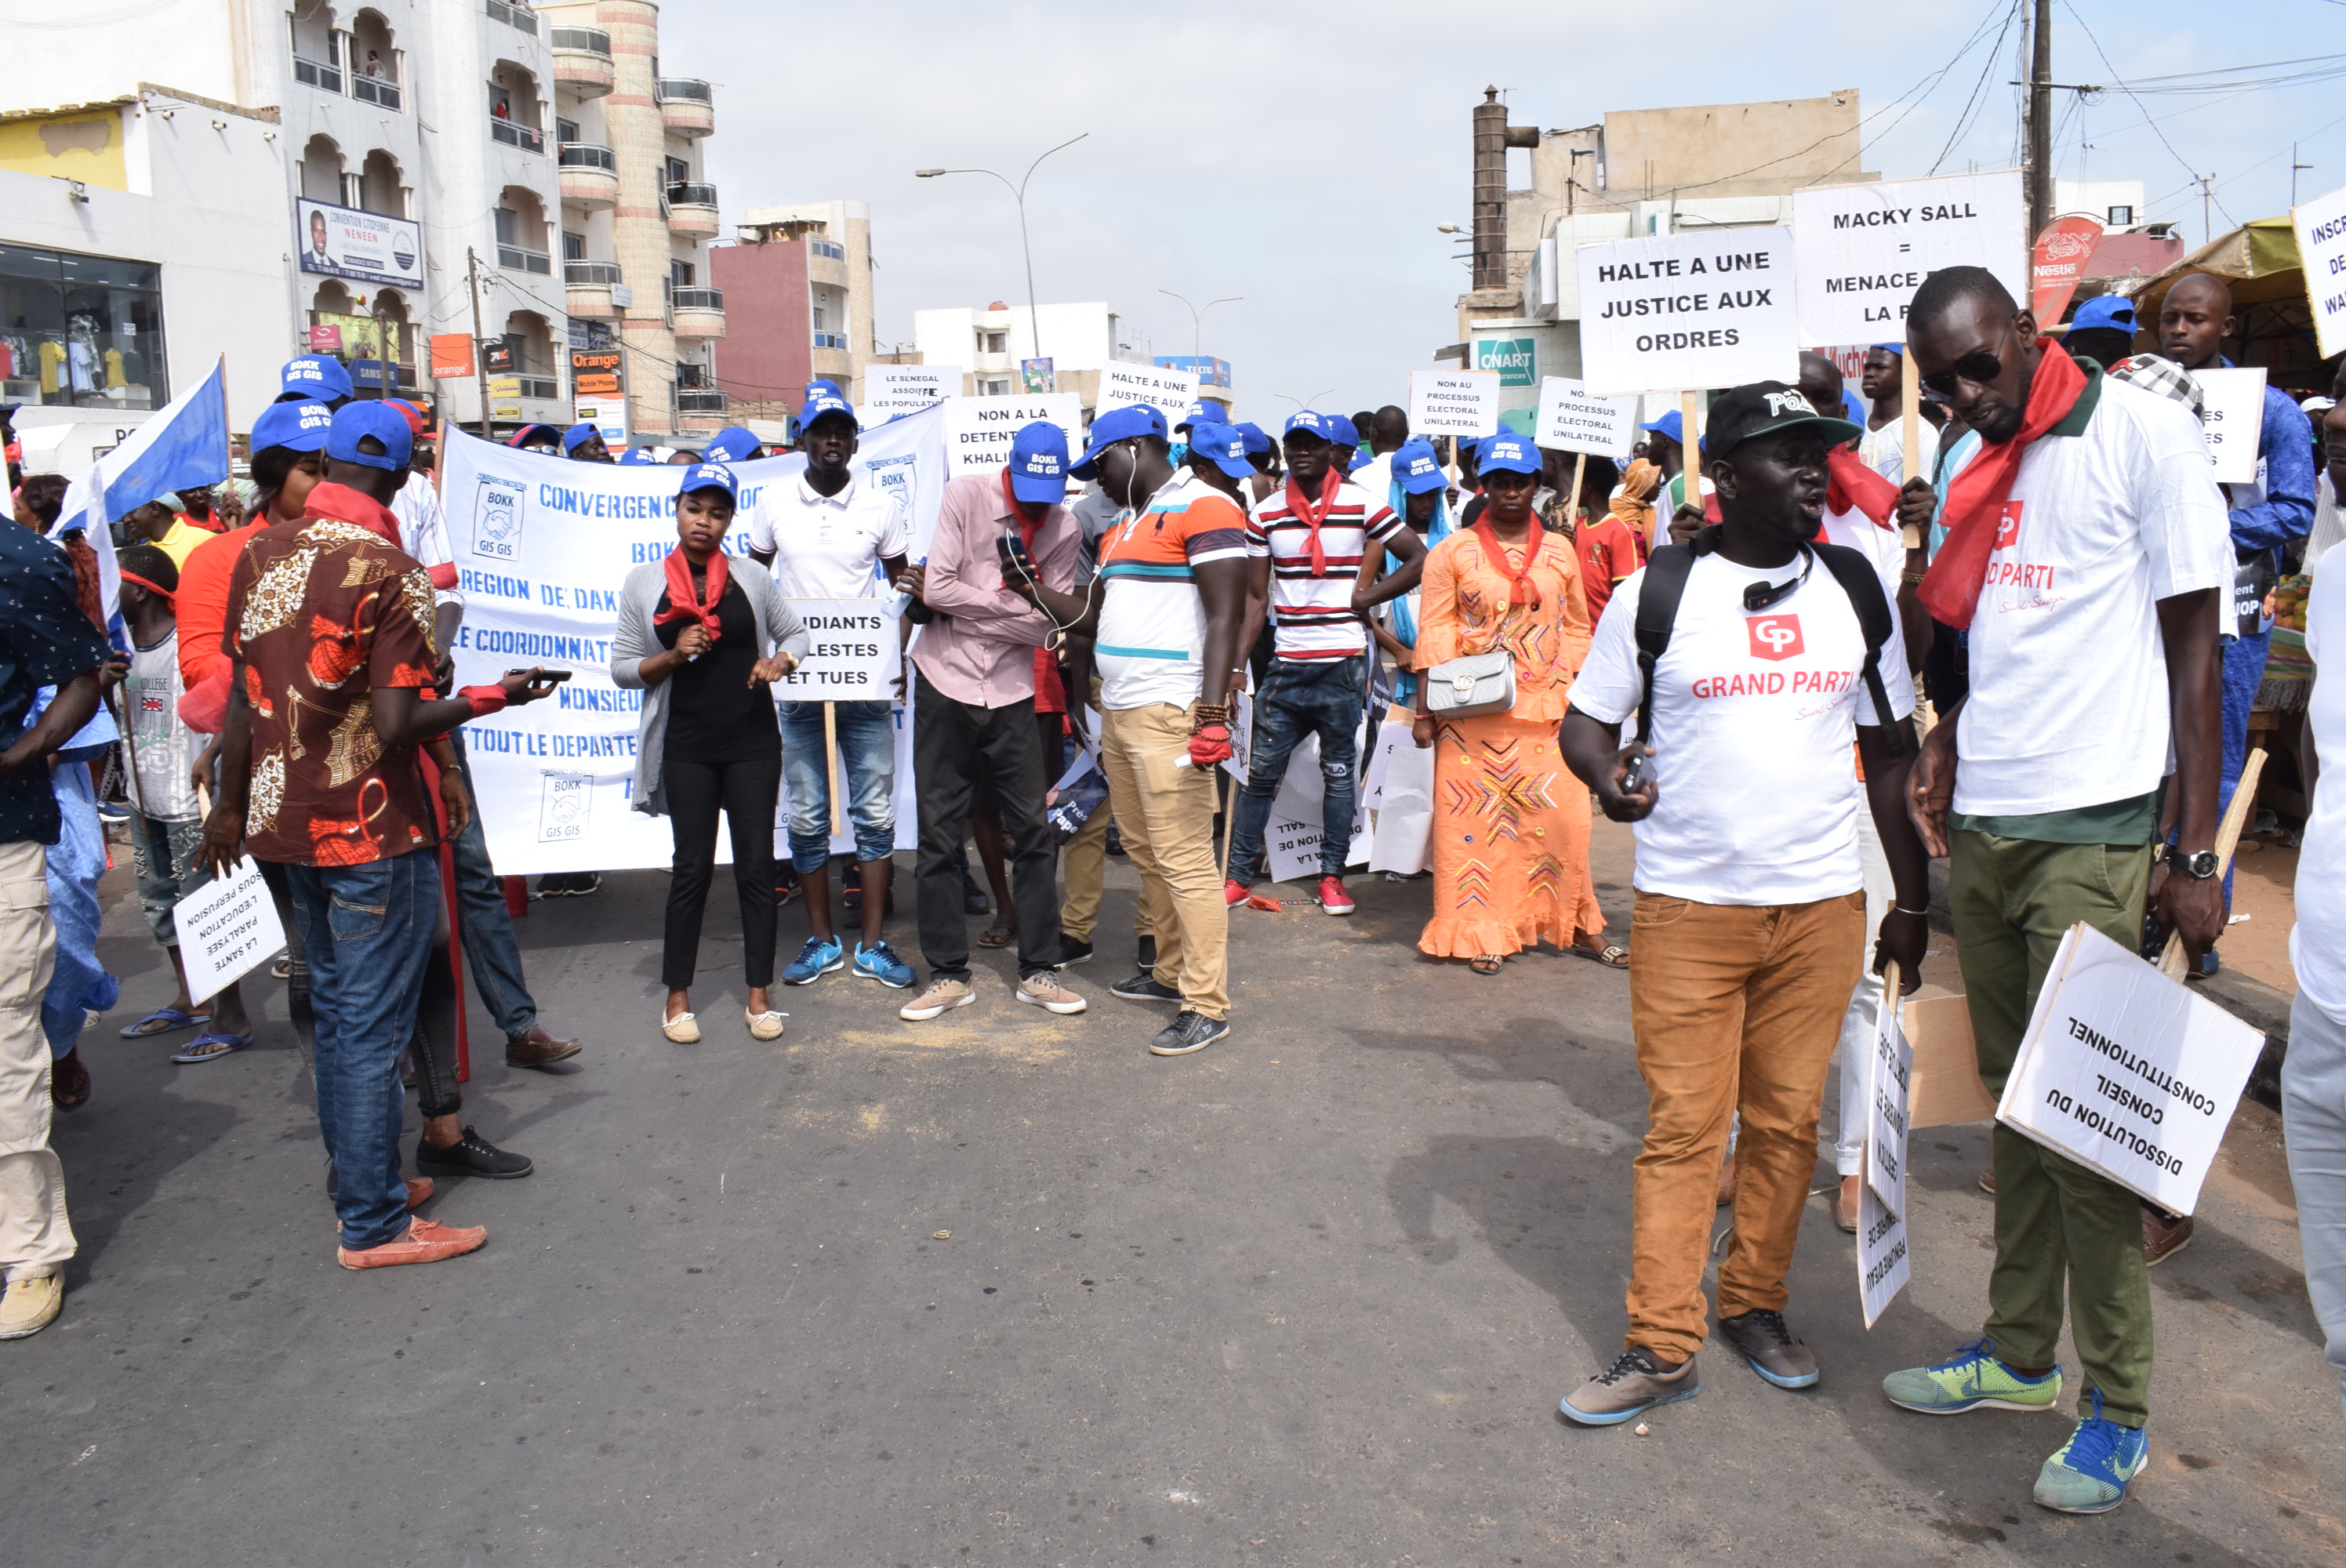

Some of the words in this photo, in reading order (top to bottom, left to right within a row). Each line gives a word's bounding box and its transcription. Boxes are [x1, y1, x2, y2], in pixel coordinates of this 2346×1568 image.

[330, 212, 361, 227] CONVENTION
[363, 218, 390, 234] CITOYENNE
[1833, 208, 1912, 229] MACKY
[1920, 203, 1977, 222] SALL
[345, 228, 378, 242] NENEEN
[1599, 260, 1680, 282] HALTE
[1690, 257, 1707, 274] A
[1716, 252, 1770, 273] UNE
[1826, 272, 1919, 293] MENACE
[1600, 294, 1709, 319] JUSTICE
[1717, 289, 1773, 310] AUX
[2325, 291, 2346, 315] WA
[1864, 307, 1891, 322] LA
[1636, 328, 1740, 352] ORDRES
[289, 361, 320, 371] BOKK
[572, 354, 619, 369] Orange
[286, 370, 302, 383] GIS
[303, 370, 323, 381] GIS
[360, 368, 395, 380] SAMSG
[434, 365, 467, 376] orange
[1186, 365, 1213, 374] TECNO
[1111, 372, 1149, 387] HALTE
[1152, 379, 1160, 388] A
[1164, 381, 1188, 393] UNE
[1437, 380, 1458, 389] NON
[818, 397, 844, 406] BOKK
[1109, 390, 1157, 405] JUSTICE
[1161, 398, 1186, 409] AUX
[1427, 393, 1480, 402] PROCESSUS
[1571, 390, 1585, 398] NO
[979, 410, 1009, 421] NON
[1015, 410, 1025, 419] A
[1030, 408, 1048, 419] LA
[1295, 412, 1317, 421] BOKK
[1427, 405, 1479, 415] ELECTORAL
[1559, 402, 1617, 416] PROCESSUS
[300, 416, 322, 430] GIS
[1424, 418, 1480, 428] UNILATERAL
[1557, 416, 1614, 430] ELECTORAL
[961, 430, 1016, 443] DETENT
[1553, 430, 1614, 445] UNILATERAL
[1495, 442, 1520, 452] BOKK
[717, 452, 732, 462] GIS
[964, 452, 1010, 464] KHALI
[1032, 453, 1057, 464] BOKK
[1411, 457, 1431, 467] BOKK
[1491, 451, 1505, 459] GIS
[1506, 451, 1523, 460] GIS
[703, 464, 730, 478] BOKK
[1026, 463, 1044, 473] GIS
[1045, 465, 1060, 474] GIS
[1411, 467, 1424, 476] GIS
[1424, 463, 1436, 473] GIS
[697, 470, 715, 479] GIS
[716, 474, 731, 488] GIS
[881, 472, 906, 487] BOKK
[487, 492, 514, 507] BOKK
[539, 483, 675, 519] CONVERGENC
[479, 539, 495, 553] GIS
[496, 543, 513, 556] GIS
[631, 541, 674, 564] BOK
[1999, 562, 2054, 590] PARTI
[461, 568, 530, 601] REGION
[540, 583, 567, 608] DE
[574, 586, 620, 612] DAK
[803, 616, 881, 630] DIANTS
[1756, 620, 1796, 652] GP
[476, 629, 614, 663] COORDONNAT
[140, 677, 168, 691] COLLEGE
[787, 671, 811, 684] ET
[817, 671, 868, 684] TUES
[1692, 672, 1785, 699] GRAND
[1792, 671, 1854, 694] PARTI
[558, 686, 644, 713] MONSIEU
[470, 726, 524, 755] TOUT
[528, 733, 547, 757] LE
[553, 735, 638, 757] DEPARTE
[554, 780, 582, 792] BOKK
[1051, 810, 1079, 834] Pape
[547, 827, 561, 838] GIS
[565, 826, 580, 837] GIS
[1279, 841, 1295, 851] DE
[1296, 853, 1312, 865] LA
[238, 870, 262, 893] SOUS
[187, 888, 237, 928] PERFUSION
[199, 895, 258, 941] L'EDUCATION
[206, 916, 258, 956] PARALYSEE
[245, 936, 258, 950] LA
[214, 946, 245, 972] SANTE
[2068, 1016, 2216, 1116] CONSTITUTIONNEL
[2046, 1088, 2073, 1115] DU
[2097, 1073, 2164, 1125] CONSEIL
[2074, 1103, 2184, 1177] DISSOLUTION
[1877, 1213, 1897, 1241] ENURIE
[1868, 1226, 1876, 1249] DE
[1883, 1237, 1906, 1275] PENURIE
[1866, 1260, 1884, 1294] D'EAU
